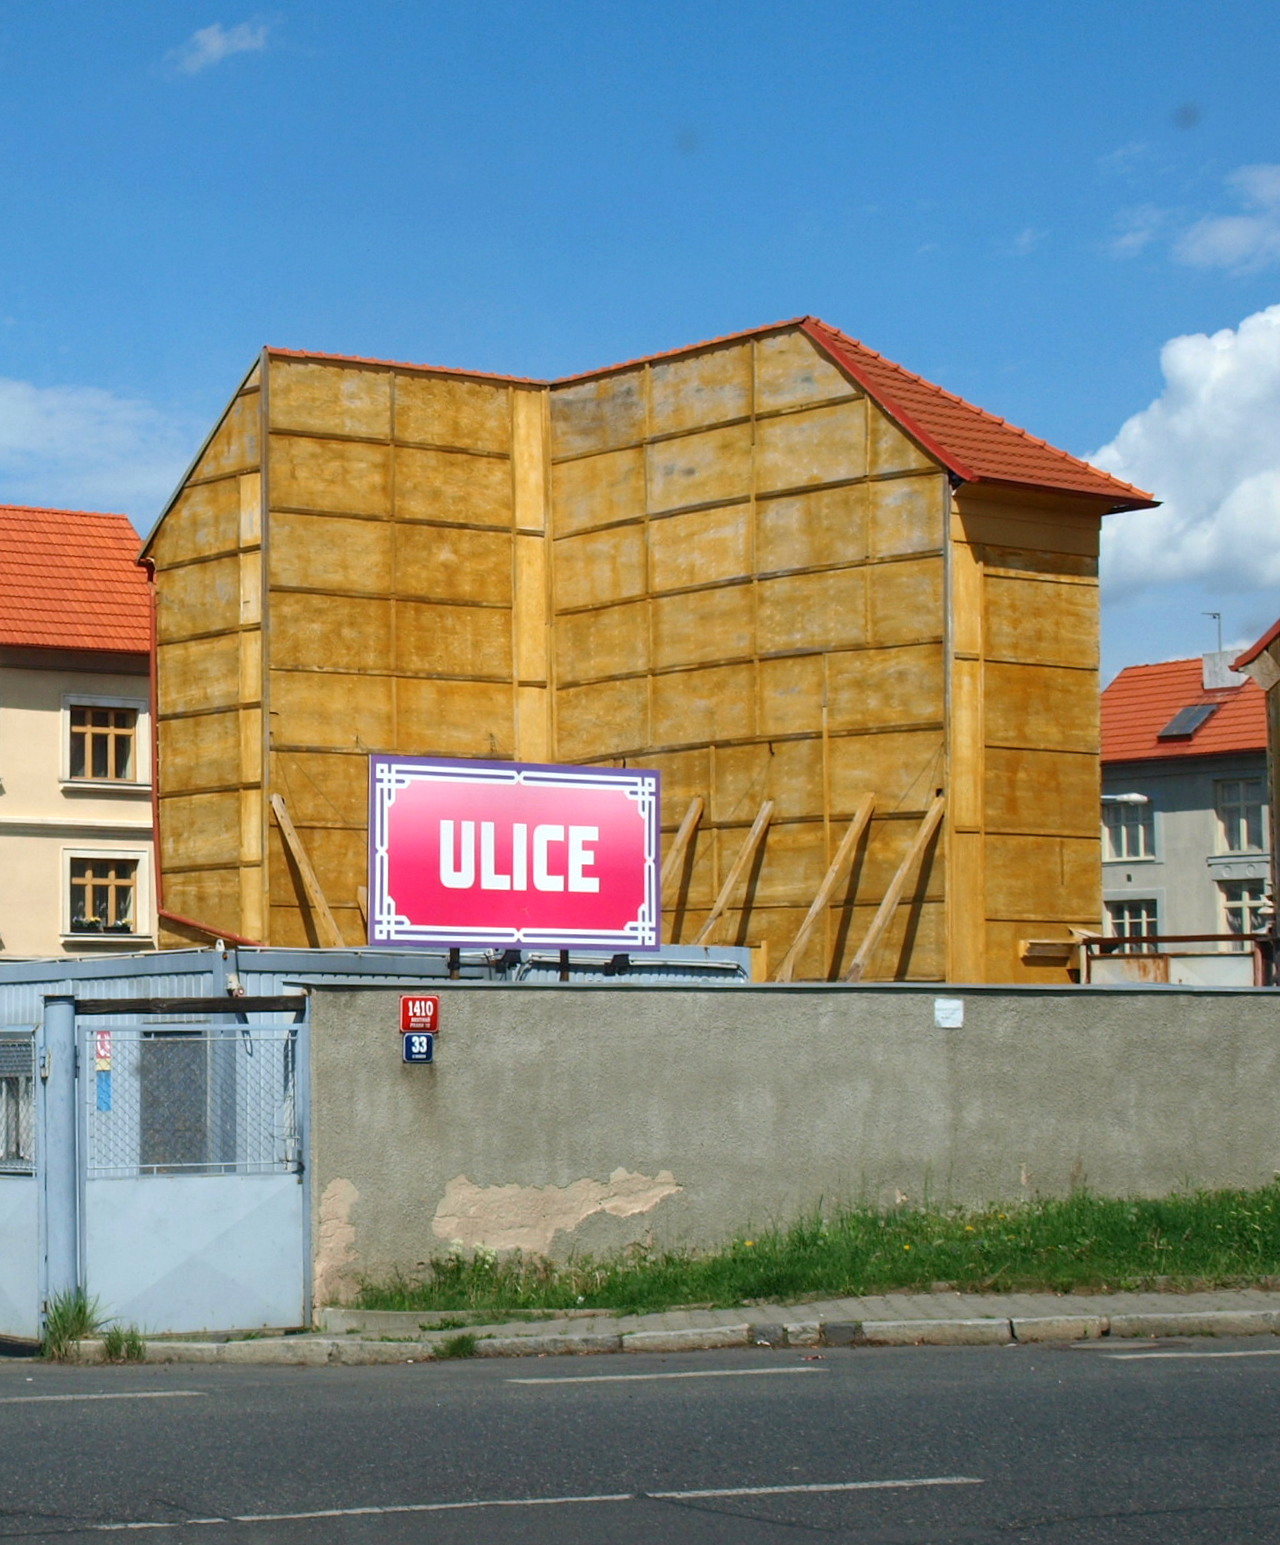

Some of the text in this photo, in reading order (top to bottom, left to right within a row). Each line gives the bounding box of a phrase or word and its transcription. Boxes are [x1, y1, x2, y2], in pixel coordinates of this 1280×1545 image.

[439, 819, 600, 894] ULICE
[408, 1000, 434, 1017] 1410
[411, 1036, 428, 1054] 33
